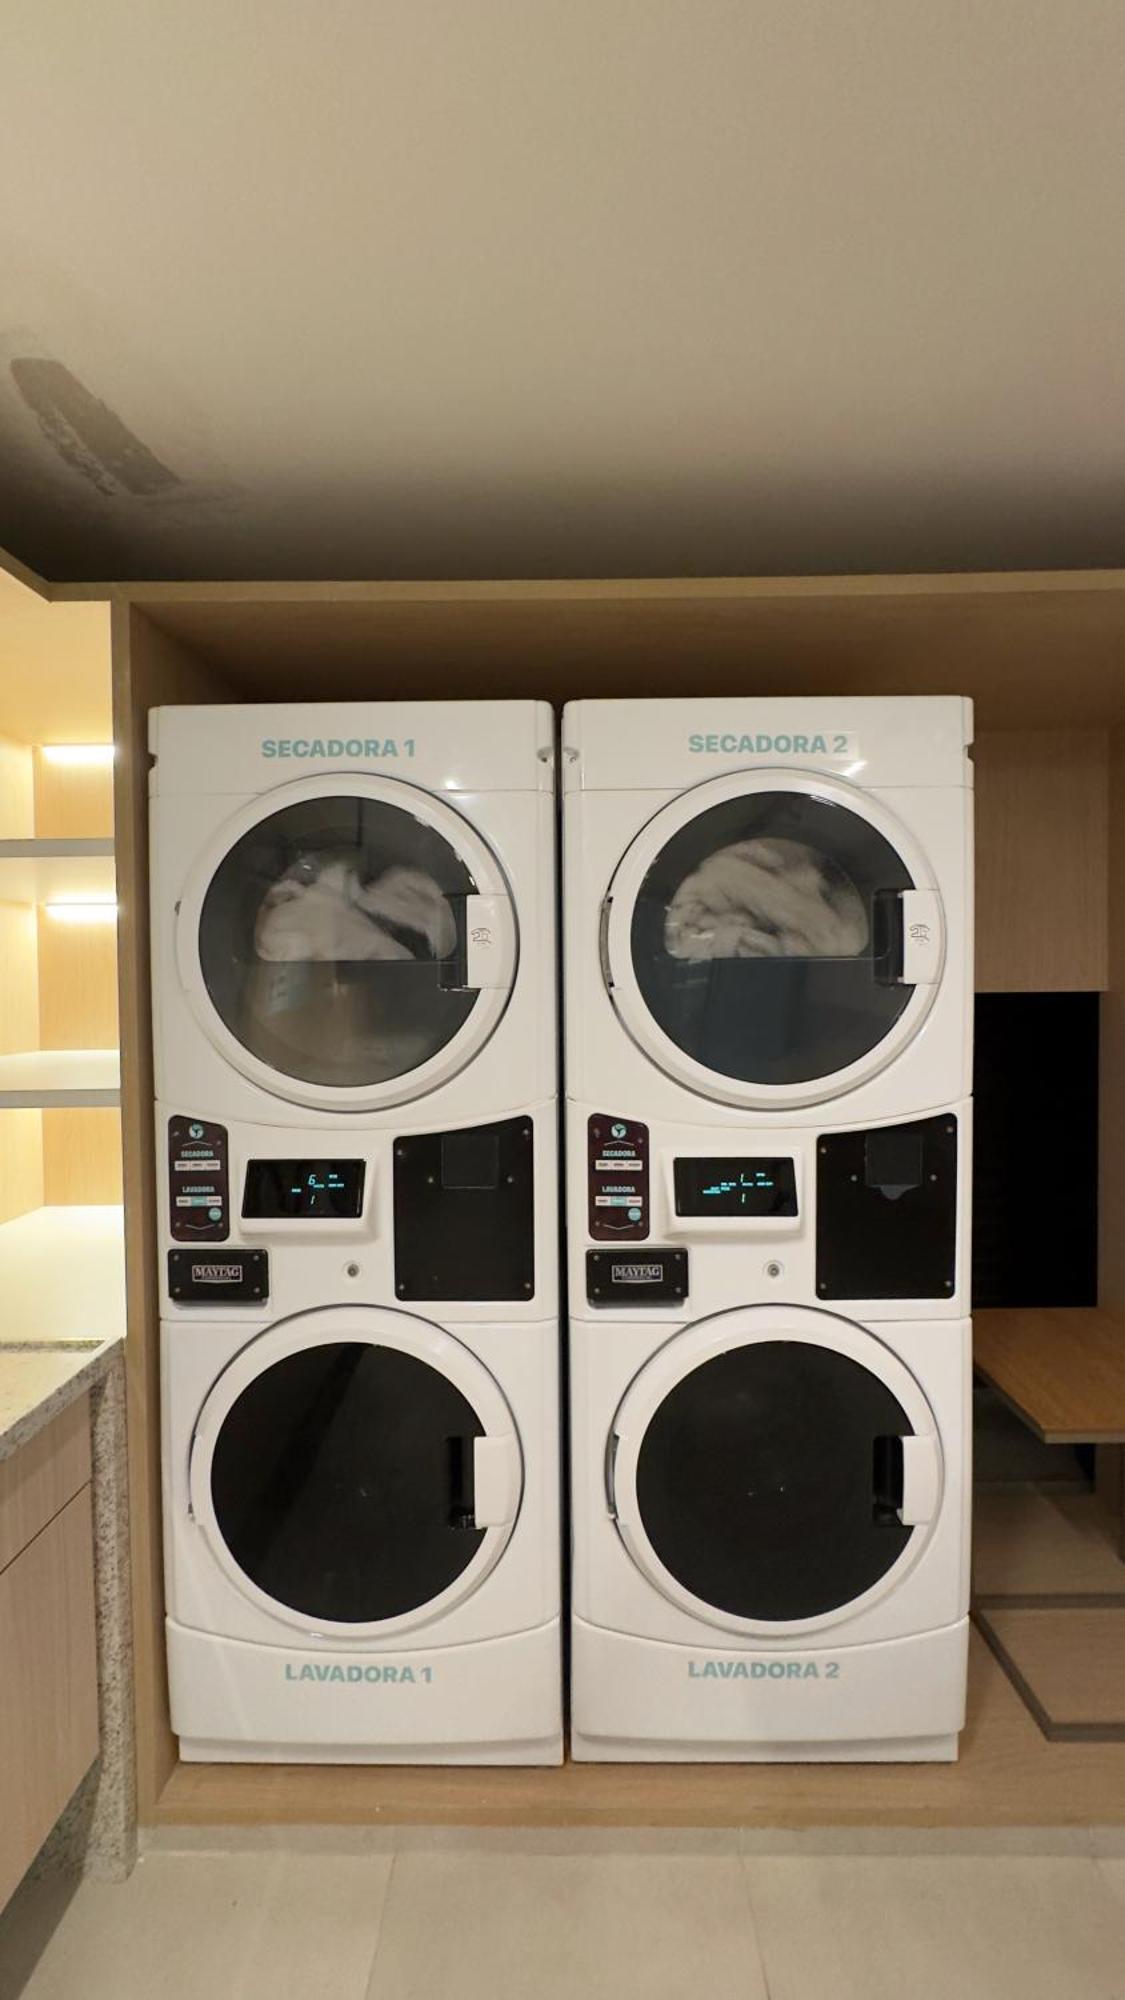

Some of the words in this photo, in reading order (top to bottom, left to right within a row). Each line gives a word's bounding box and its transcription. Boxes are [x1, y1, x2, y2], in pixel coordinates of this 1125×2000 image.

[261, 738, 398, 758] SECADORA
[403, 738, 415, 758] 1
[688, 733, 827, 753] SECADORA
[832, 734, 848, 753] 2
[195, 1267, 240, 1277] MAYTAG
[615, 1267, 660, 1277] MAYTAG
[285, 1663, 416, 1683] LAVADORA
[420, 1666, 432, 1684] 1
[688, 1660, 819, 1679] LAVADORA
[825, 1661, 841, 1679] 2
